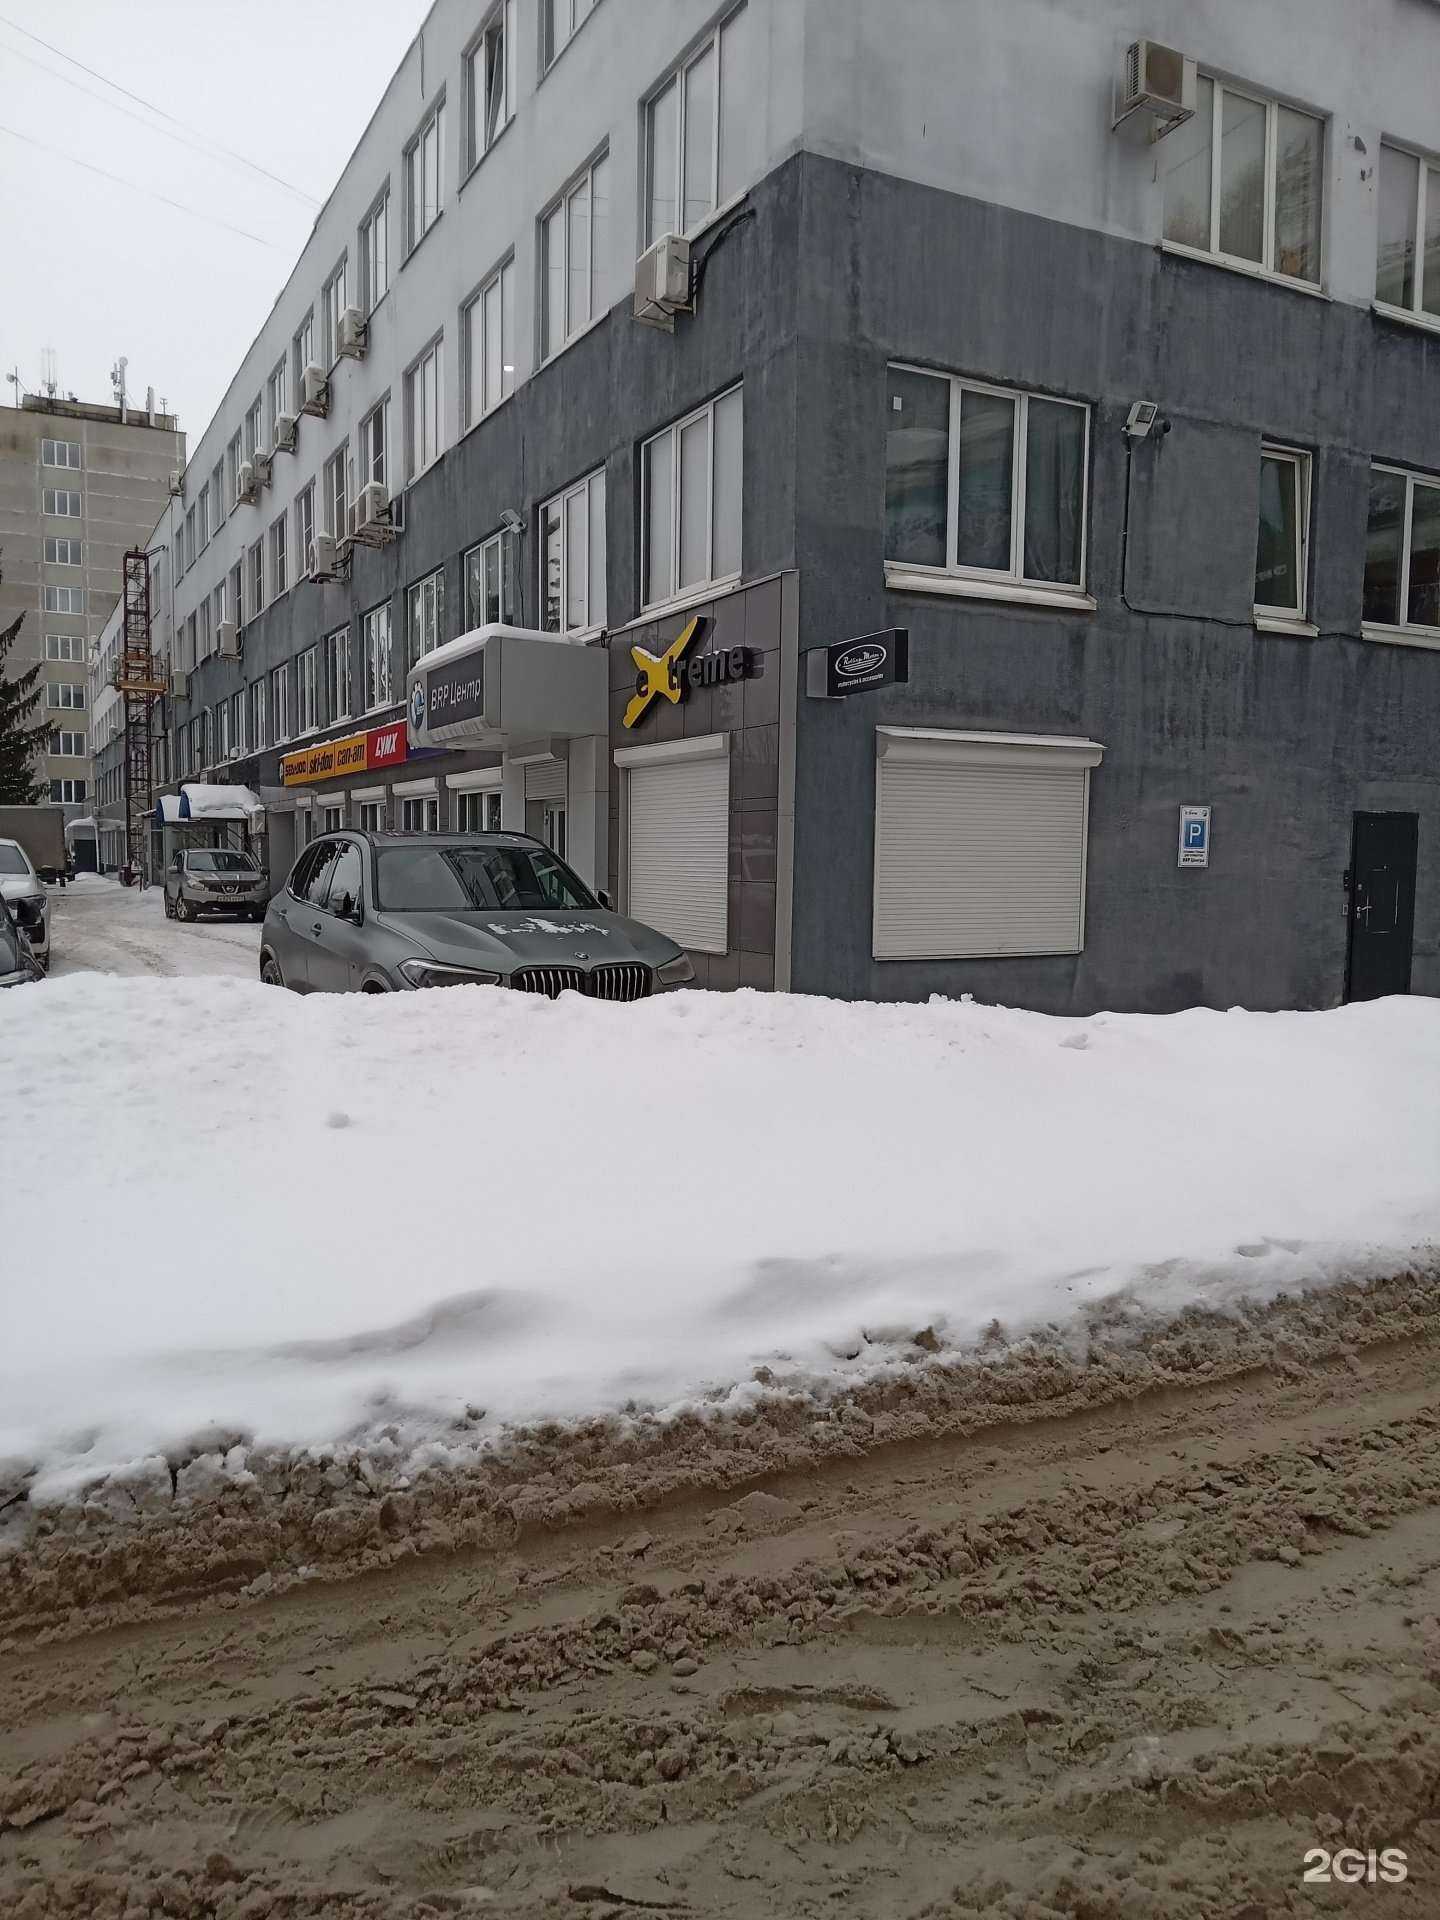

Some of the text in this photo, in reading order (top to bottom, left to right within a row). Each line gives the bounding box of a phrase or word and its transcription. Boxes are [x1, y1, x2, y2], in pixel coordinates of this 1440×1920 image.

[430, 679, 481, 711] BRP Центр
[375, 733, 398, 758] LYNX
[1190, 823, 1201, 843] P
